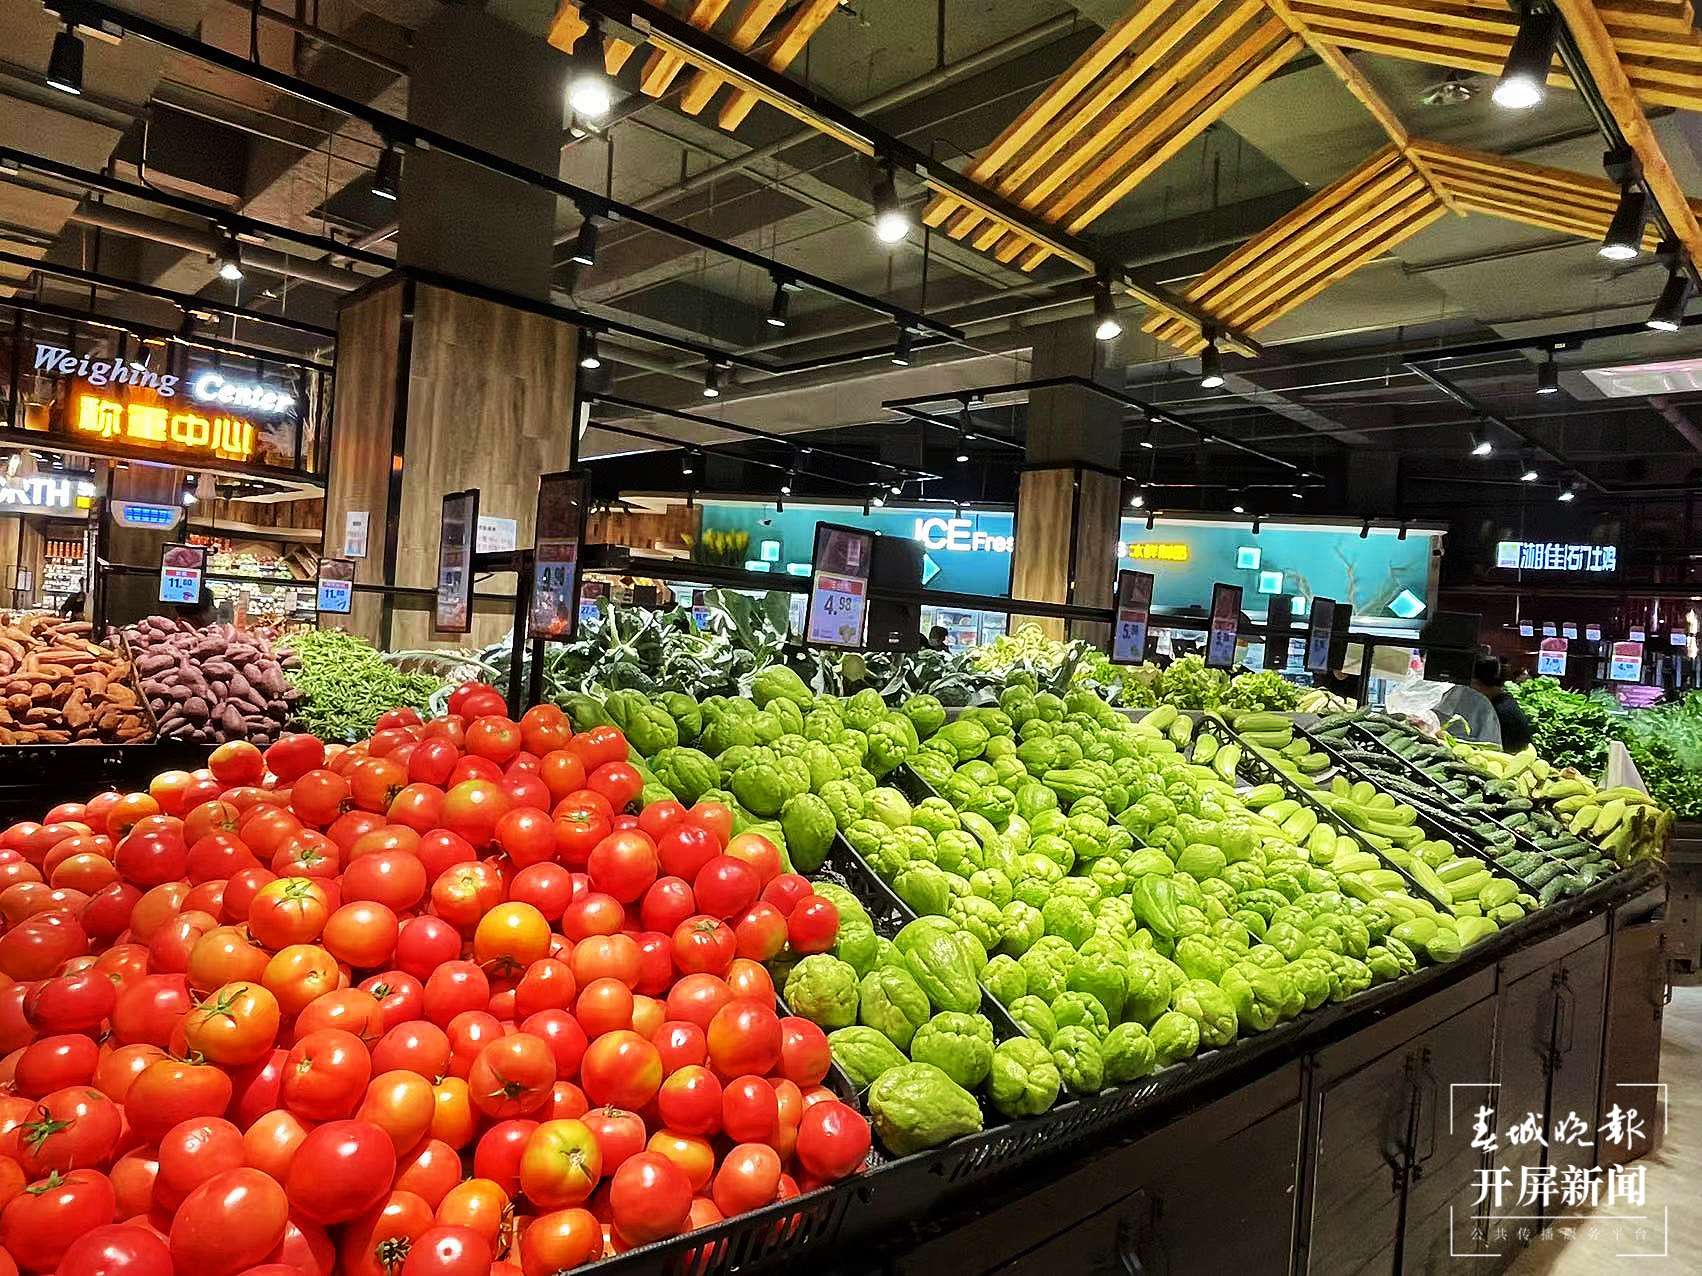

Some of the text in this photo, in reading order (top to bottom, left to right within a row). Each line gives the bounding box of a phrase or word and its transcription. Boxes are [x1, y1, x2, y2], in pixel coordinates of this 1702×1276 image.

[34, 344, 296, 413] Weighing Center
[914, 517, 1014, 552] ICE Fres
[823, 594, 852, 616] 4.98
